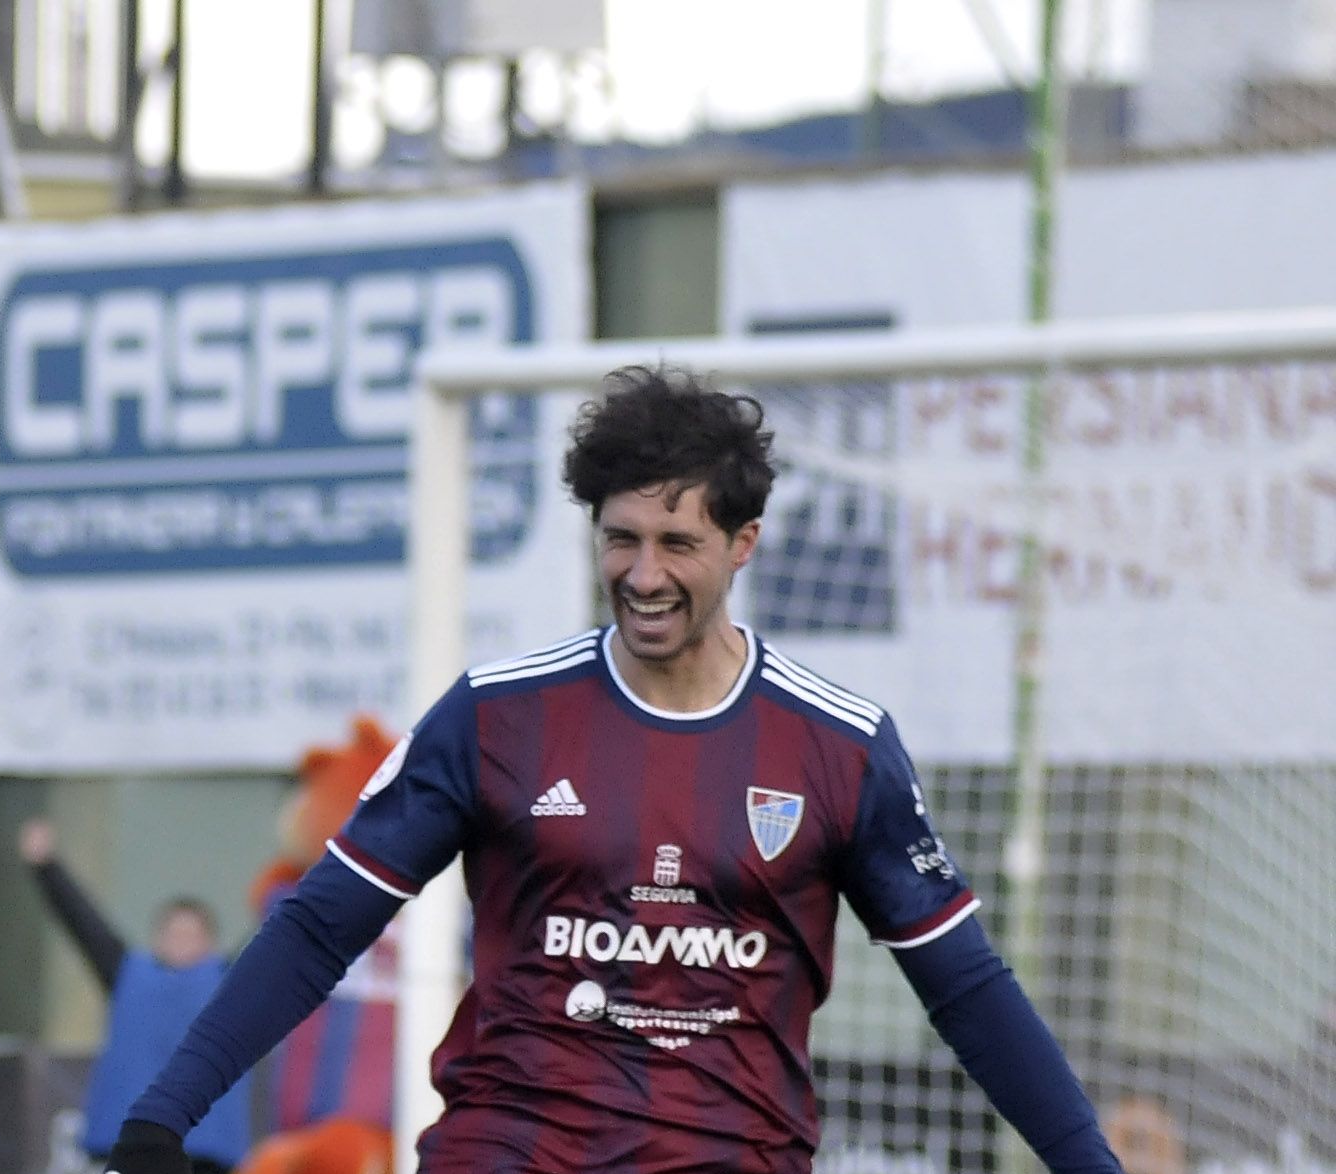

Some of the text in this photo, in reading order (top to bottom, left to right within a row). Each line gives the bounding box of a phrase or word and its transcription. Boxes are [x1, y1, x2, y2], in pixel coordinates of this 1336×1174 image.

[529, 803, 587, 816] adidas
[630, 885, 697, 904] SEGOVIA
[543, 915, 768, 969] BIOAMMO
